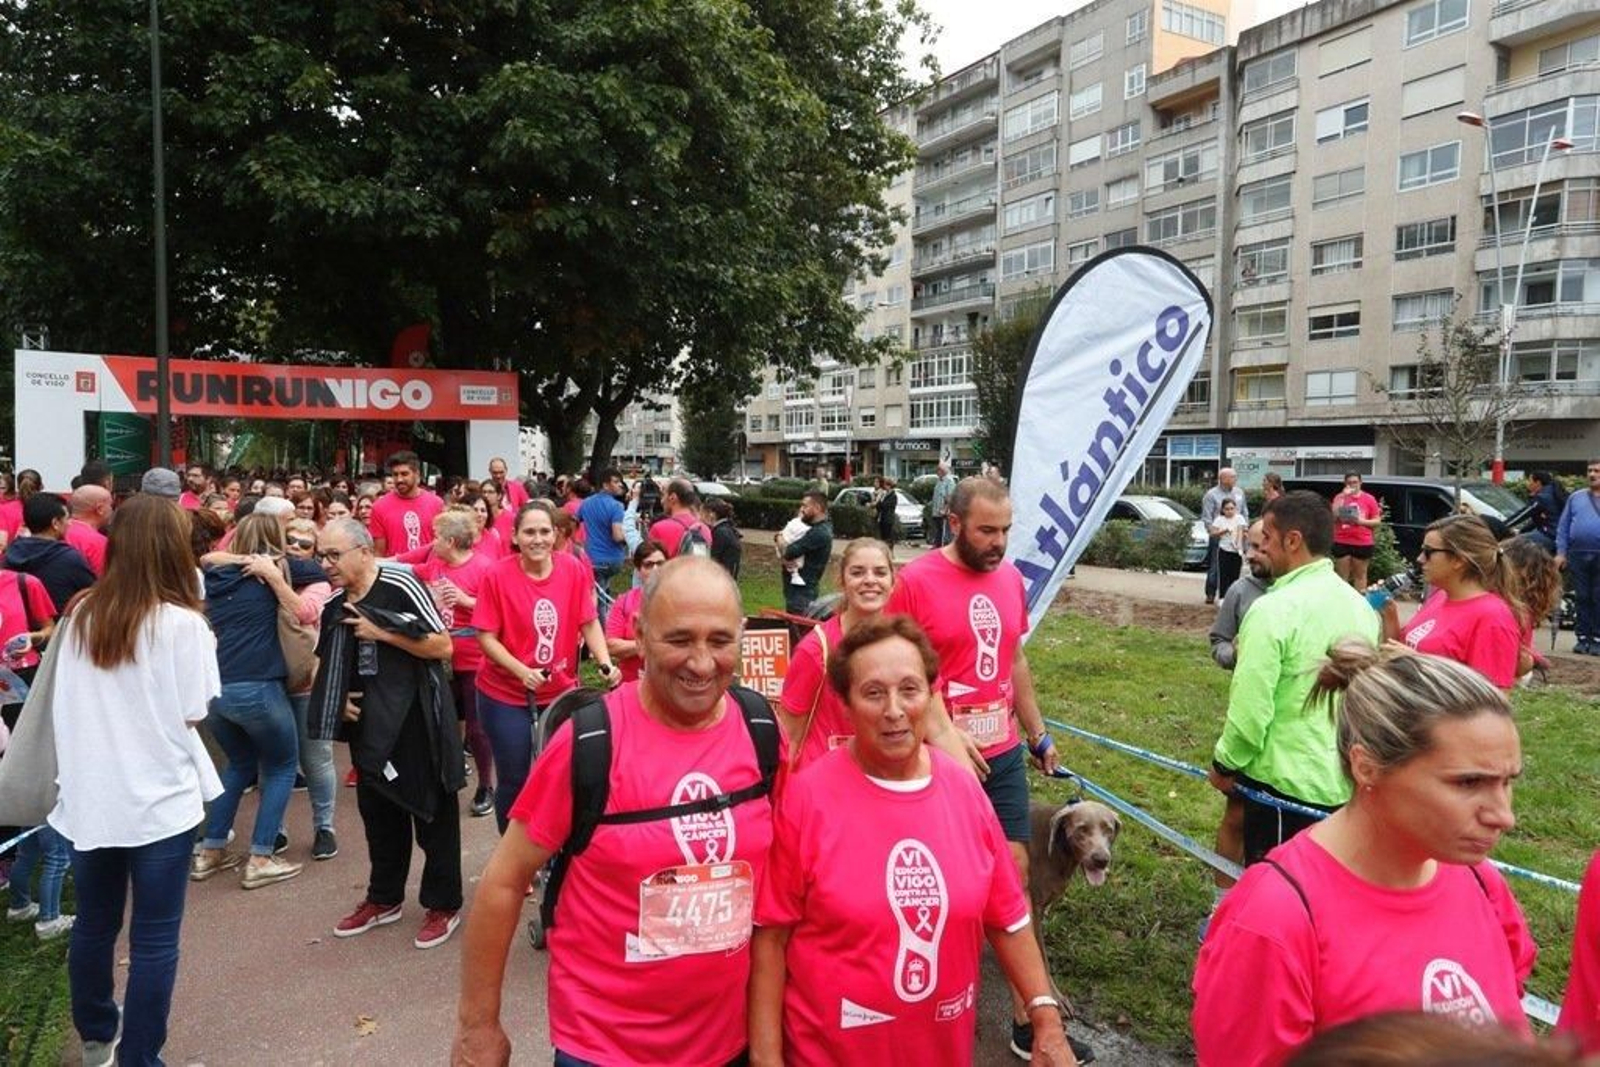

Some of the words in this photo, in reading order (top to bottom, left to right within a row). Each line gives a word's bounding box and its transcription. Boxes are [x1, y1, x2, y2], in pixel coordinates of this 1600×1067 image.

[26, 372, 70, 380] CONCELLO
[45, 380, 66, 388] VIGO
[741, 636, 785, 655] SAVE
[741, 657, 776, 676] THE
[686, 783, 707, 800] VI
[901, 850, 921, 867] VI
[895, 875, 936, 889] VIGO
[665, 890, 733, 928] 4475
[1433, 973, 1461, 999] VI
